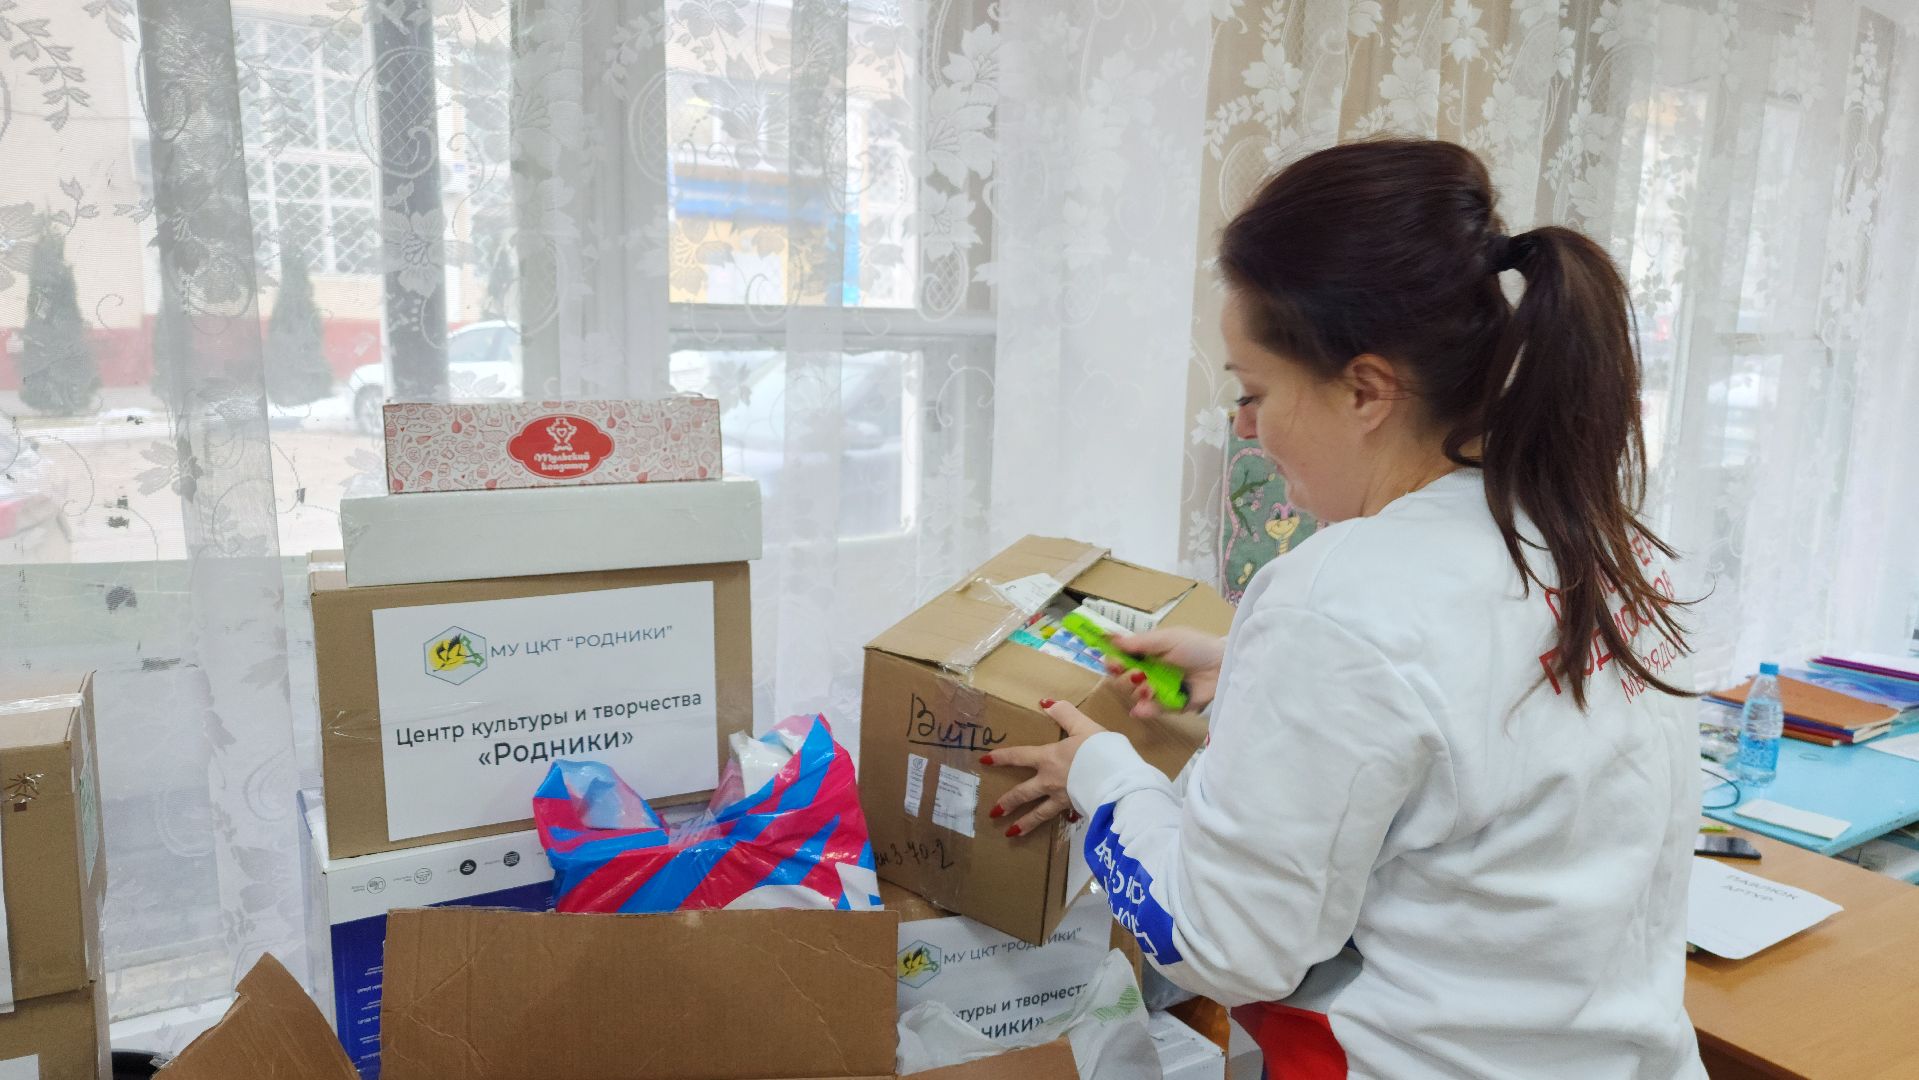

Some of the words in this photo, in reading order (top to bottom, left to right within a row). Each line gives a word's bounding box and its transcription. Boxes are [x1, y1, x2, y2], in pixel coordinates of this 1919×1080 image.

[490, 643, 520, 658] МУ
[526, 638, 562, 655] ЦКТ
[566, 625, 673, 649] “РОДНИКИ”
[396, 721, 465, 747] Центр
[471, 710, 569, 738] культуры
[575, 709, 587, 721] и
[592, 692, 702, 718] творчества
[478, 730, 634, 767] «Родники»
[944, 951, 965, 965] МУ
[970, 944, 998, 960] ЦКТ
[1001, 927, 1081, 952] “РОДИКИ”
[954, 1003, 996, 1022] туры
[1001, 998, 1011, 1011] и
